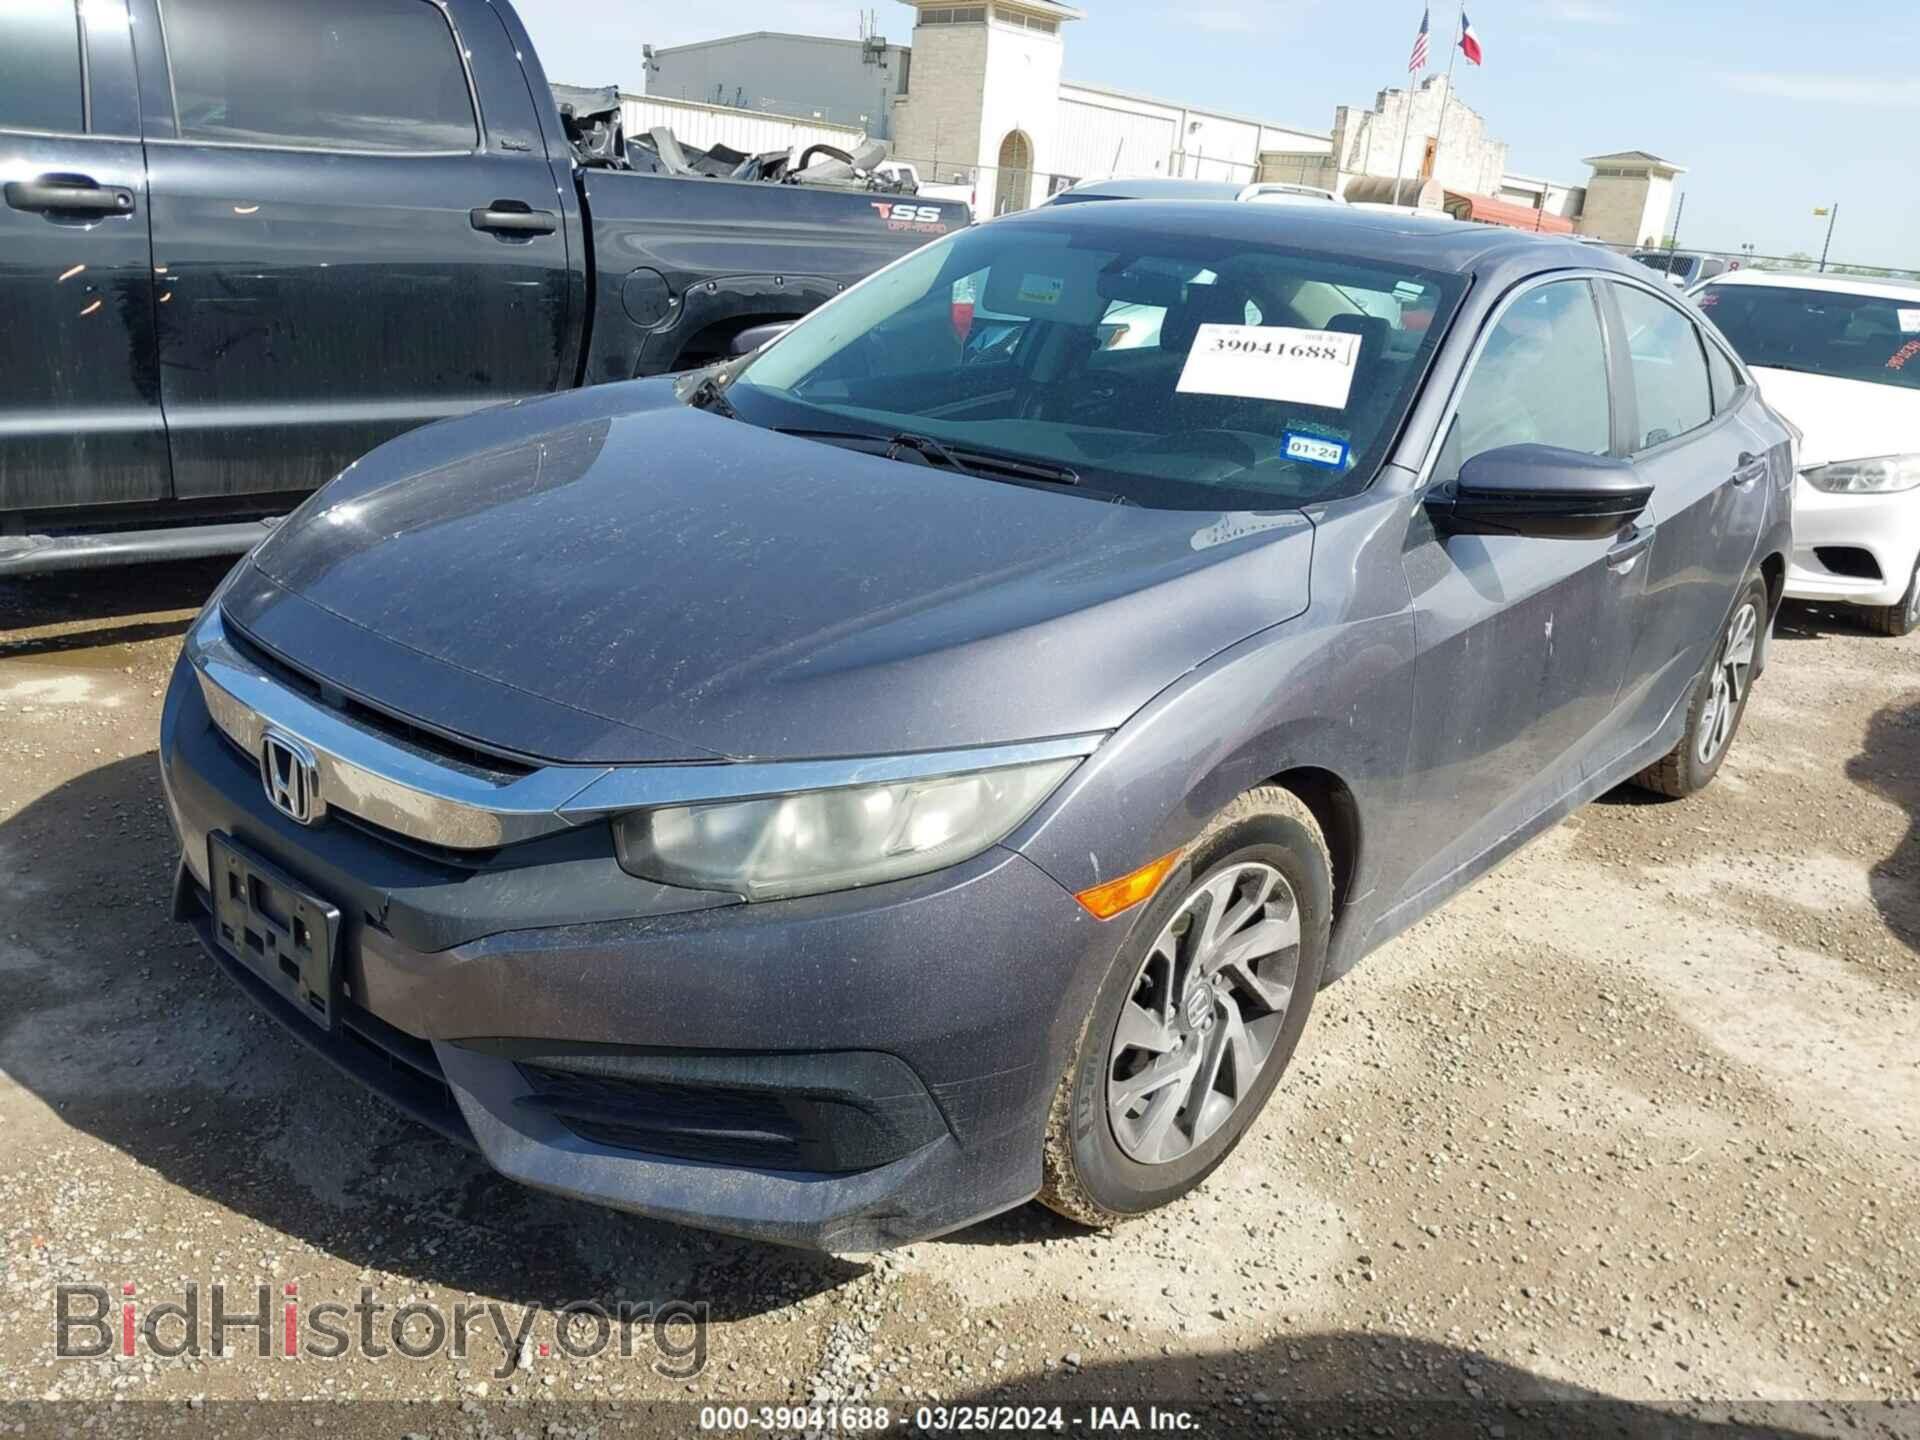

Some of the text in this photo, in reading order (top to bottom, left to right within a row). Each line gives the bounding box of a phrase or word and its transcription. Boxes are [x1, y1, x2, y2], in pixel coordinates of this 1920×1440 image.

[870, 202, 942, 223] TSS
[1211, 338, 1337, 361] 39041688
[1291, 442, 1338, 459] 01-24
